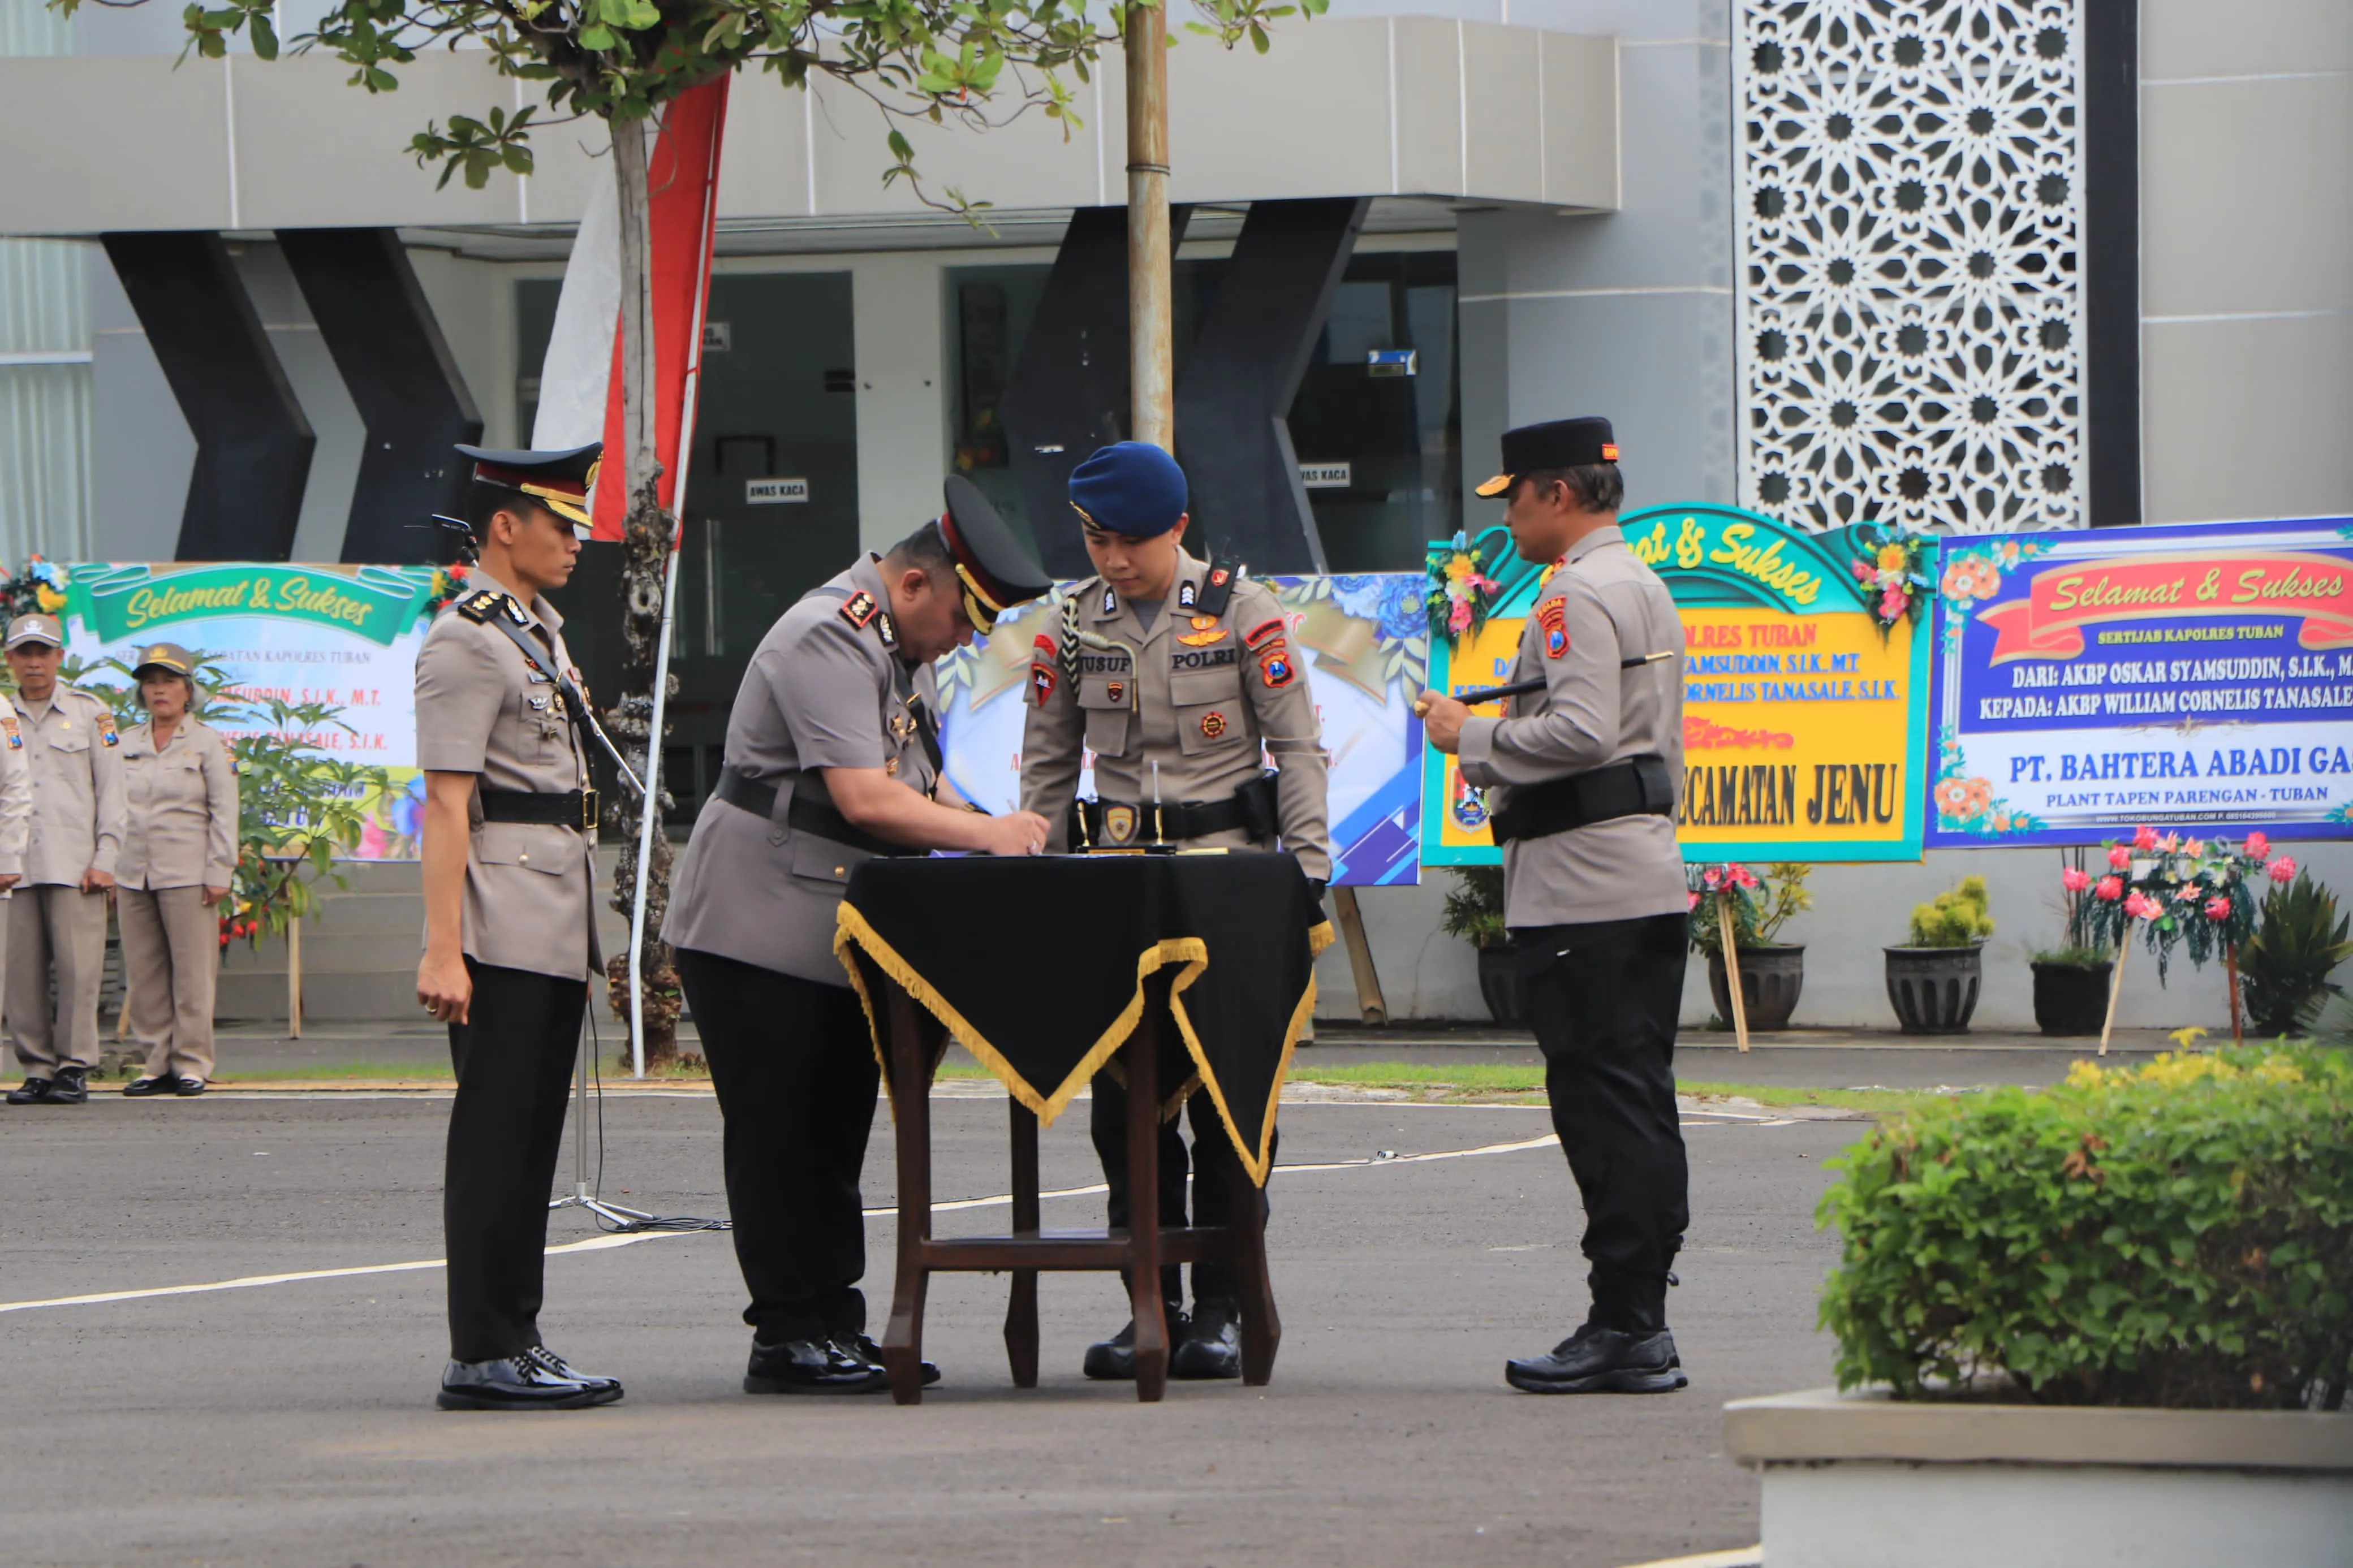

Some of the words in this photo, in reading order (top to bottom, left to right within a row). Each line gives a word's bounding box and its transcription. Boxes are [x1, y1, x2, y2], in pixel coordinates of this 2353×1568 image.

[1301, 470, 1317, 481] AS
[1321, 470, 1346, 481] KACA
[750, 485, 777, 497] AWAS
[779, 483, 805, 496] KACA
[1675, 517, 1705, 569] &
[1709, 523, 1821, 605] Sukses
[2050, 577, 2185, 611] Selamat
[2196, 568, 2221, 602] &
[2231, 566, 2344, 603] Sukses
[126, 580, 249, 628] Selamat
[249, 577, 272, 609] &
[275, 576, 373, 626] Sukses
[1684, 624, 1742, 647] LRES
[1748, 623, 1817, 647] TUBAN
[2098, 630, 2162, 645] SERTIJAB
[2164, 628, 2234, 643] KAPOLRES
[2235, 625, 2285, 640] TUBAN
[331, 651, 371, 664] TUBAN
[1172, 649, 1236, 669] POLRI
[1683, 654, 1782, 675] AMSUDDIN,
[2012, 665, 2059, 689] DARI:
[2061, 663, 2108, 687] AKBP
[2109, 660, 2167, 685] OSKAR
[2170, 656, 2285, 683] SYAMSUDDIN,
[2288, 655, 2335, 681] S.I.K.,
[350, 689, 382, 706] M.T.
[1683, 682, 1757, 702] RNELIS
[1859, 680, 1901, 701] S.I.K.
[1979, 696, 2053, 720] KEPADA:
[2054, 693, 2102, 717] AKBP
[2104, 690, 2176, 715] WILLIAM
[2179, 688, 2261, 712] CORNELIS
[2263, 685, 2353, 710] TANASALE
[349, 733, 388, 750] S.I.K.
[2010, 755, 2052, 783] PT.
[2059, 750, 2199, 781] BAHTERA
[2207, 747, 2302, 777] ABADI
[1678, 764, 1797, 826] CAMATAN
[1806, 763, 1898, 826] JENU
[2046, 792, 2101, 807] PLANT
[2104, 791, 2160, 806] TAPEN
[2164, 788, 2258, 804] PARENGAN
[2269, 787, 2329, 802] TUBAN
